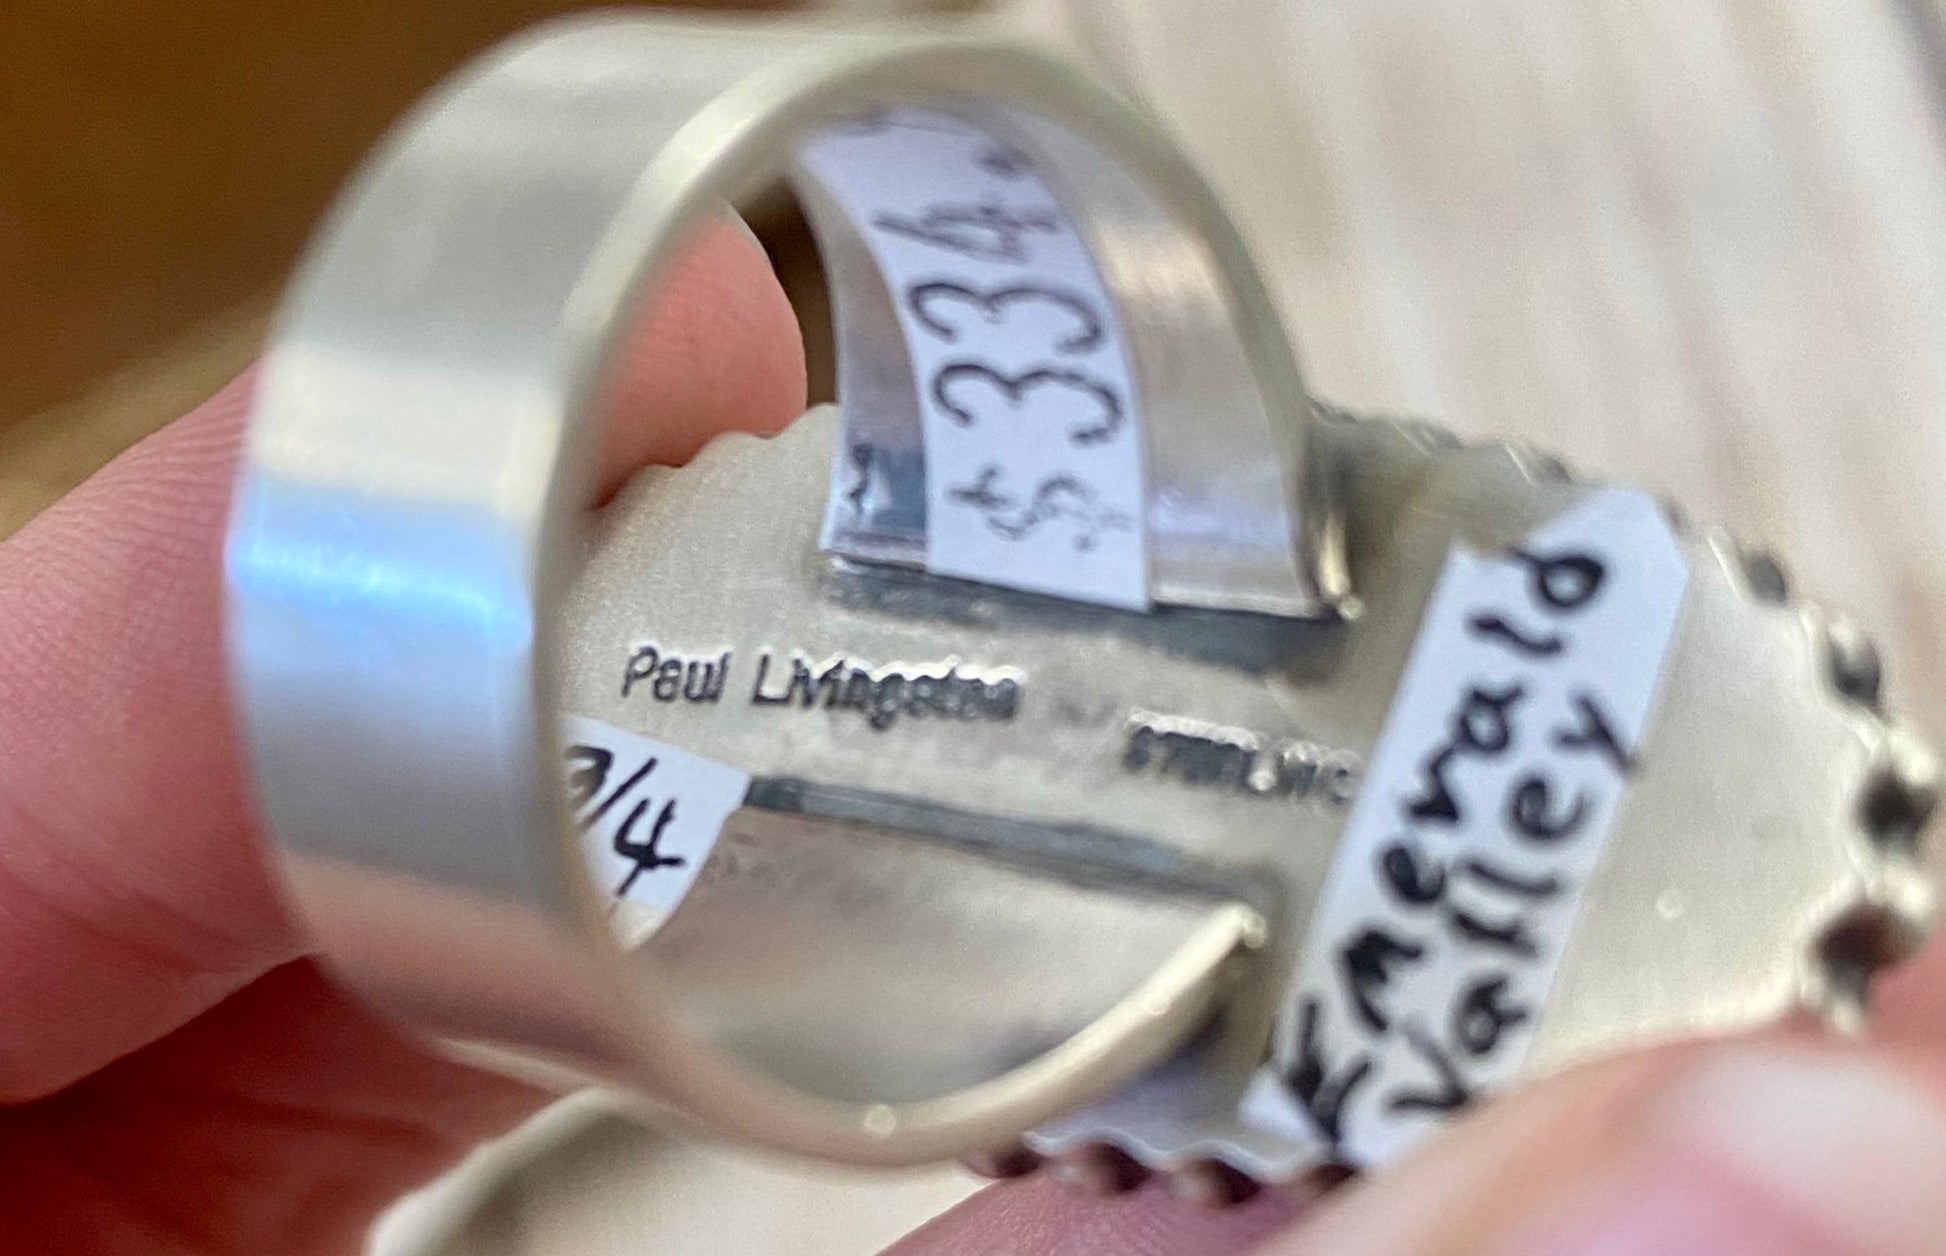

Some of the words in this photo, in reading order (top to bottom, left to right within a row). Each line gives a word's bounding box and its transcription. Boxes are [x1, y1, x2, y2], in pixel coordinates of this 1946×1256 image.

[621, 643, 731, 703] Paul
[1283, 544, 1609, 1144] Emerald
[1385, 694, 1638, 1120] Valley
